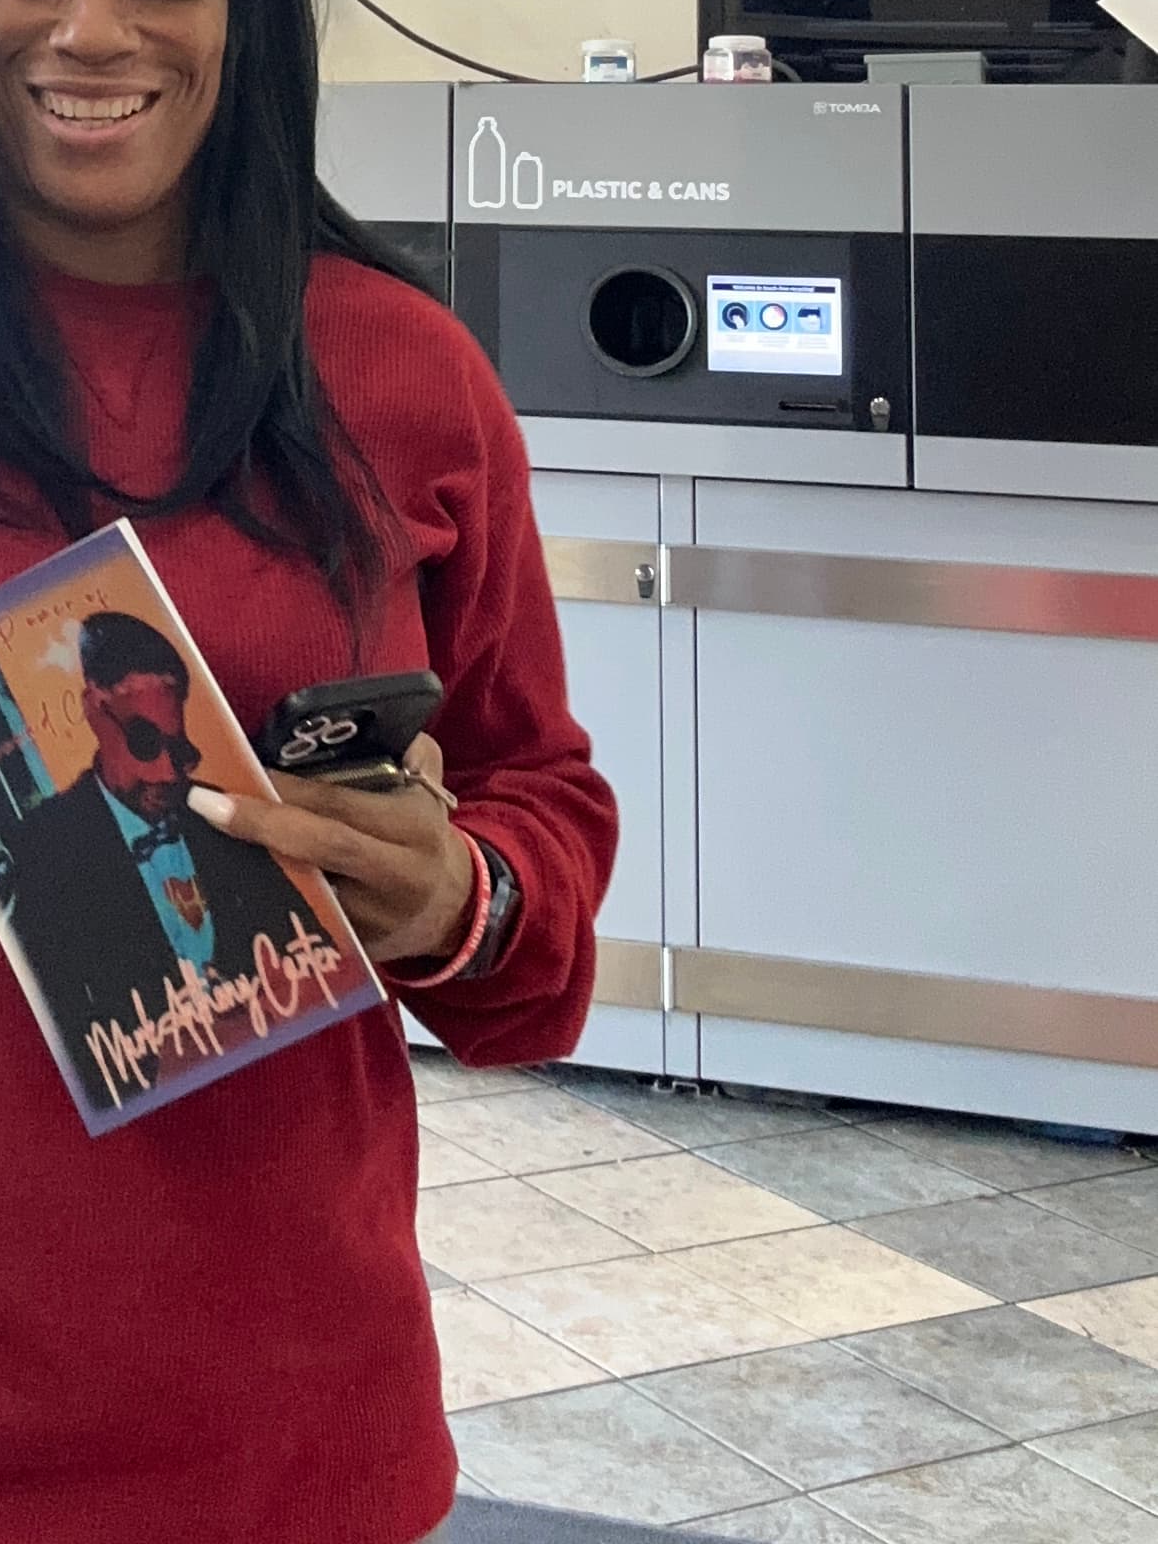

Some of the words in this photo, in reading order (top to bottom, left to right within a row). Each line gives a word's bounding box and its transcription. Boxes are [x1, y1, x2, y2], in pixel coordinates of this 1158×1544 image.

[552, 179, 642, 200] PLASTIC
[647, 181, 663, 200] &
[668, 182, 731, 201] CANS
